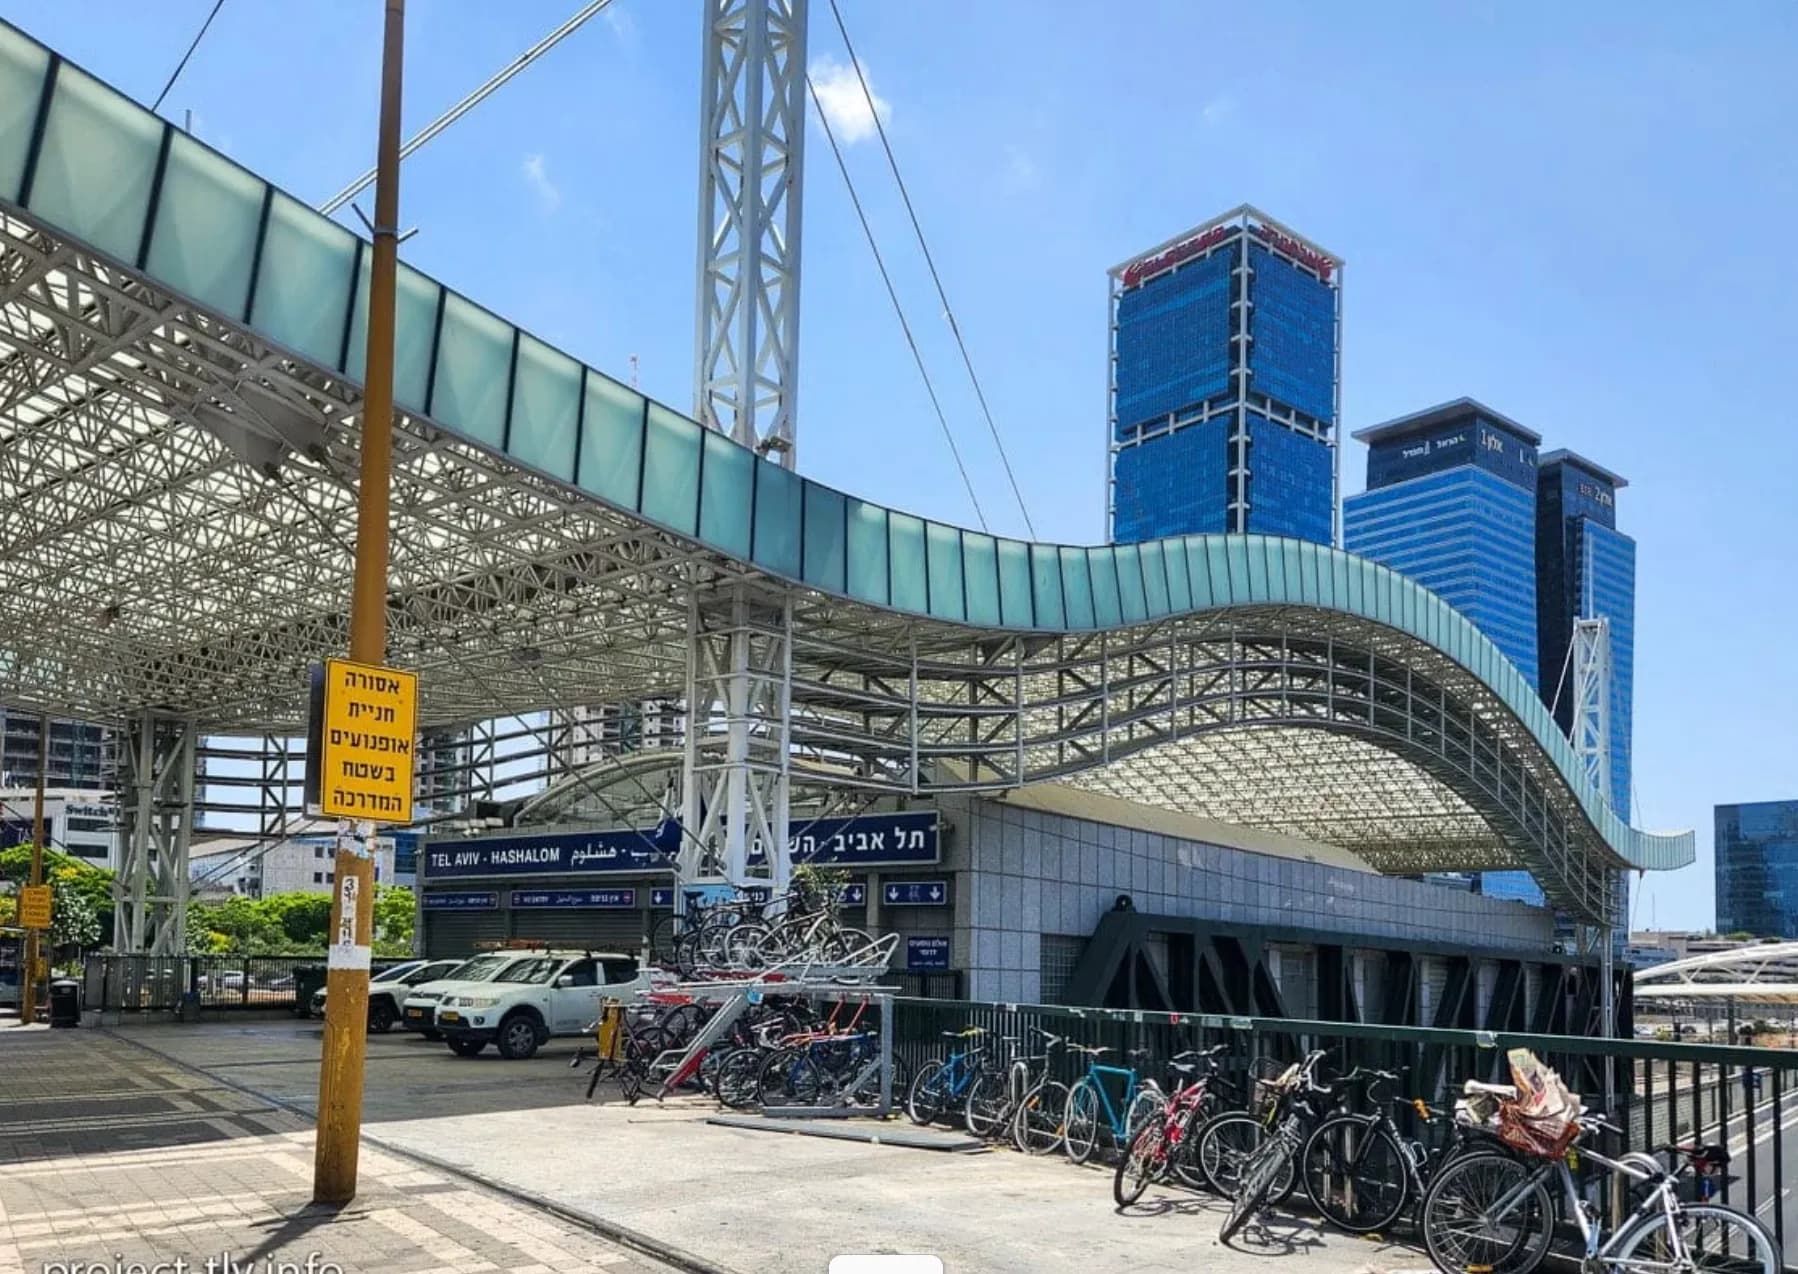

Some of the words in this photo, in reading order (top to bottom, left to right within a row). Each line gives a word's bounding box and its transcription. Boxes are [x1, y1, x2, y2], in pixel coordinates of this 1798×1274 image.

[344, 671, 400, 694] אסורה
[348, 700, 395, 723] חניית
[330, 729, 410, 755] אופנועים
[342, 760, 396, 782] בשטח
[333, 789, 402, 812] המדרכה
[834, 831, 885, 852] אביב
[894, 826, 925, 849] תל
[431, 853, 452, 868] TEL
[454, 851, 480, 866] AVIV
[490, 847, 561, 864] HASHALOM
